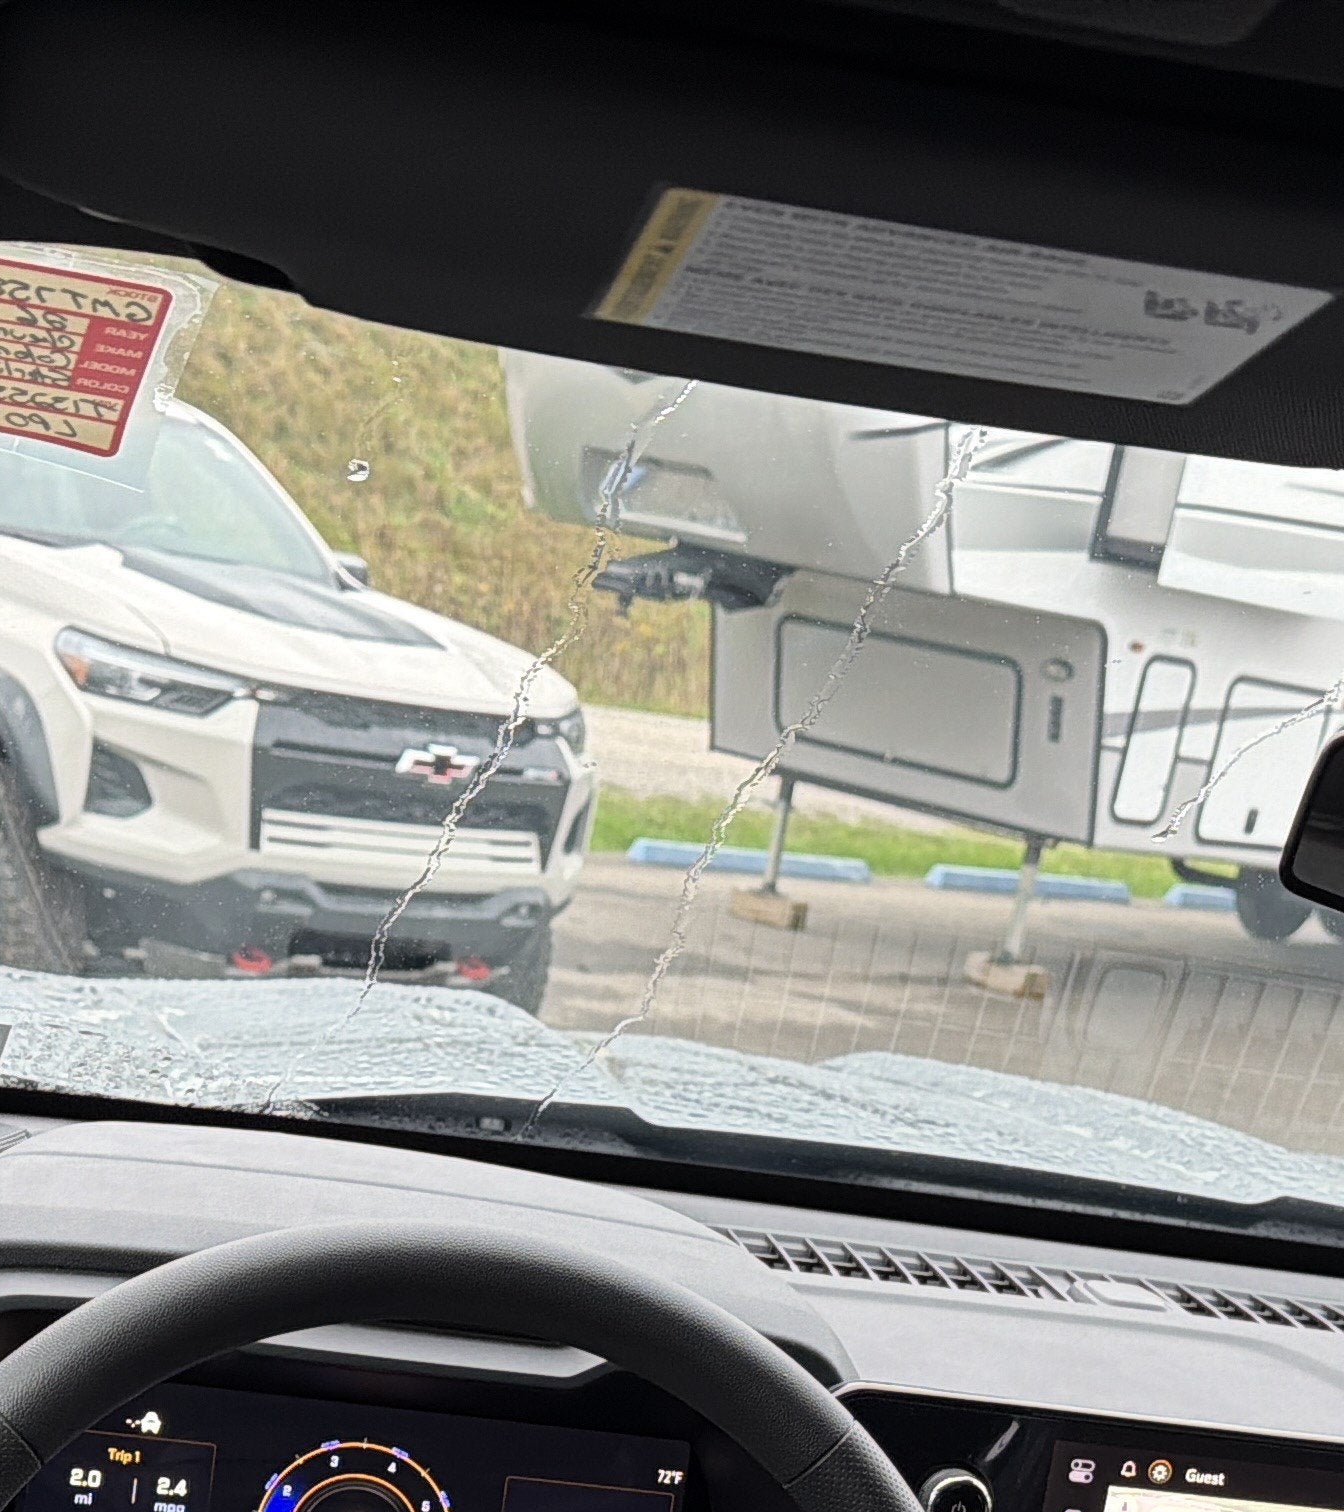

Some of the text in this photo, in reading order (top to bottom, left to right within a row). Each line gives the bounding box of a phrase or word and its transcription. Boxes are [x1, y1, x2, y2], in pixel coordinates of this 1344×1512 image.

[108, 1447, 141, 1465] Trip 1
[329, 1455, 340, 1468] 3
[387, 1461, 398, 1474] 4
[69, 1468, 102, 1488] 2.0
[1184, 1468, 1226, 1487] Guest
[156, 1477, 188, 1497] 2.4
[282, 1484, 293, 1498] 2
[74, 1492, 93, 1506] mi
[420, 1500, 431, 1512] 5
